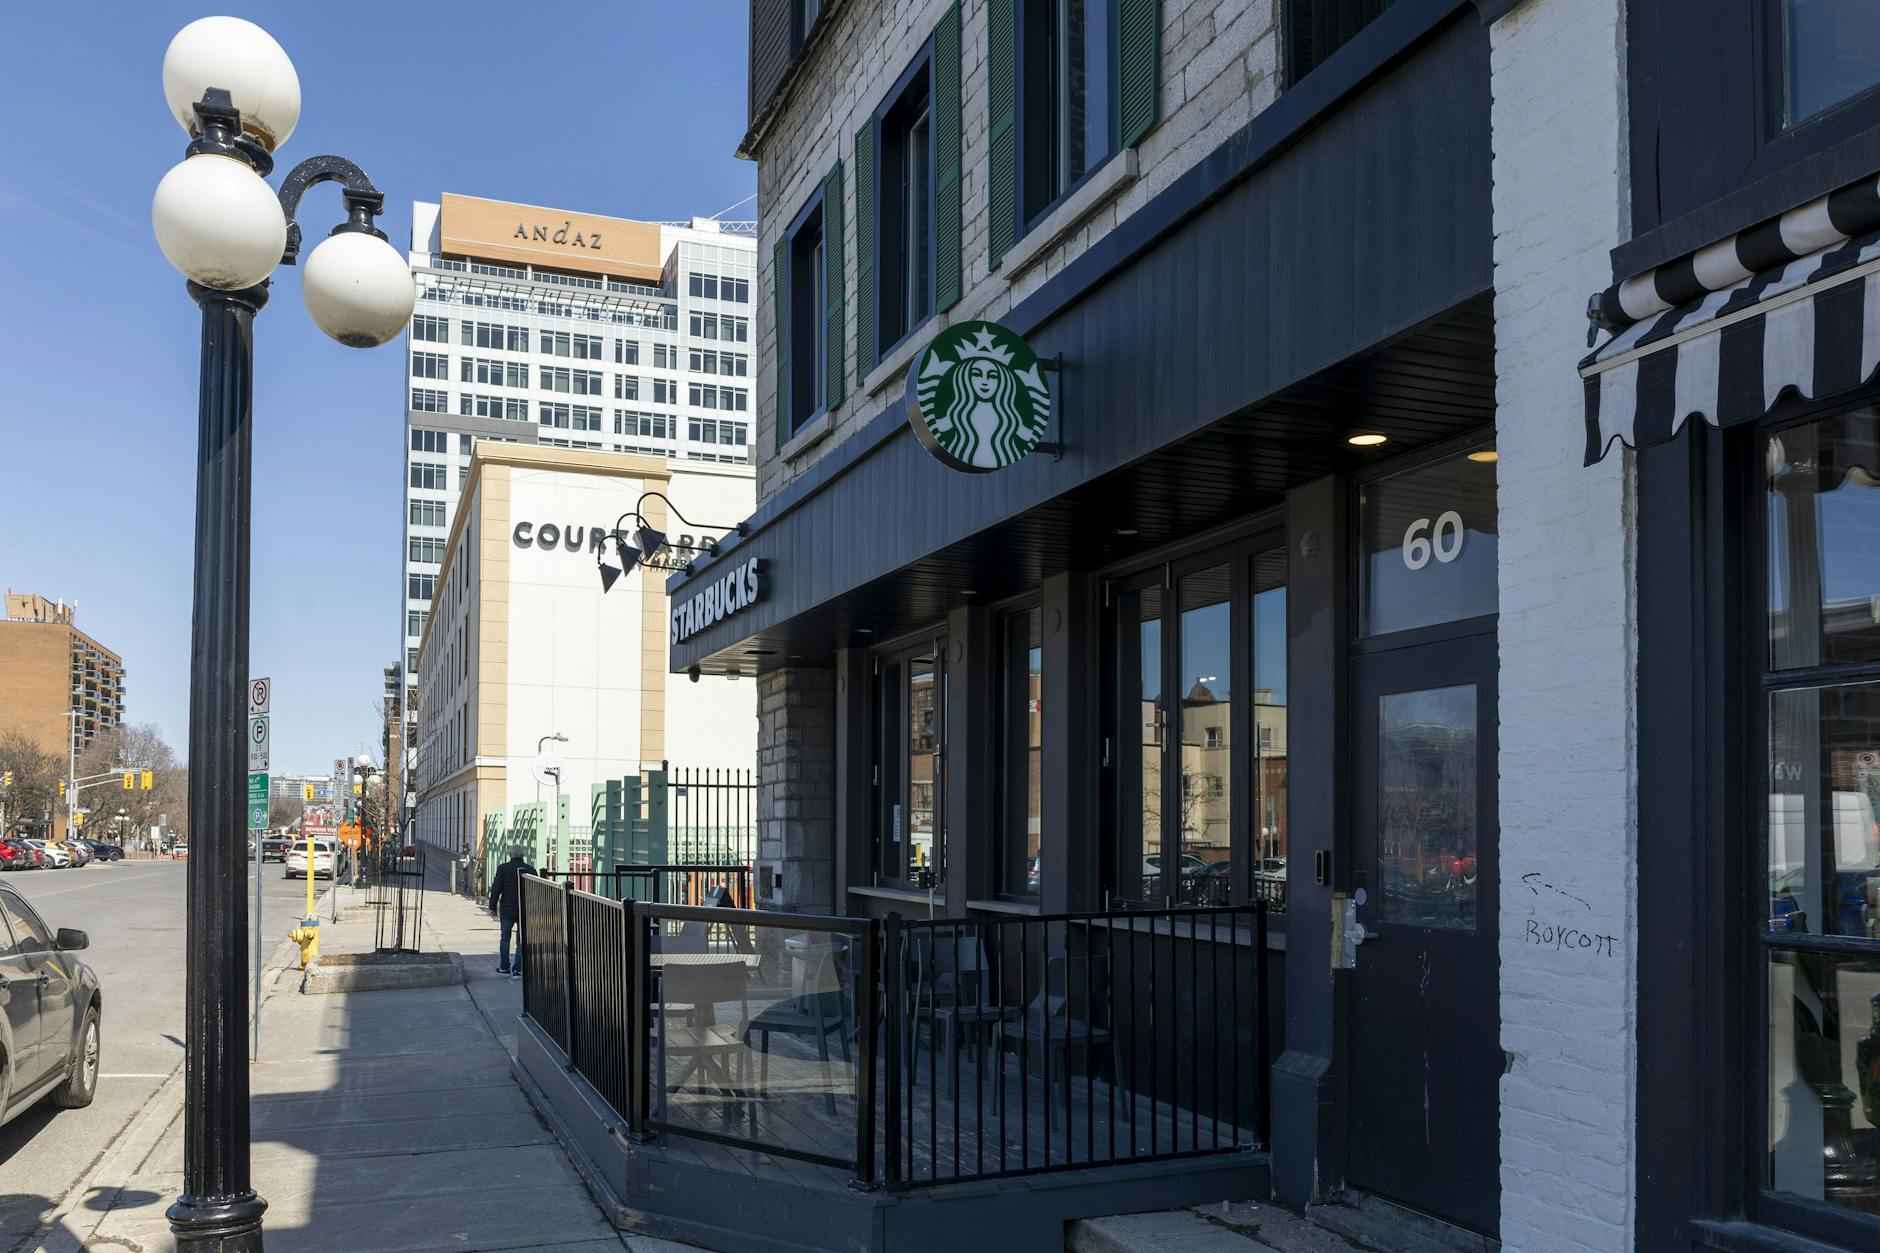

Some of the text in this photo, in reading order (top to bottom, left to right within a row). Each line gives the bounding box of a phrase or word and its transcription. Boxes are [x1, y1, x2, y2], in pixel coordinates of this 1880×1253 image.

[1402, 511, 1464, 571] 60
[671, 557, 759, 646] STARBUCKS
[1525, 919, 1619, 958] BOYCOTT
